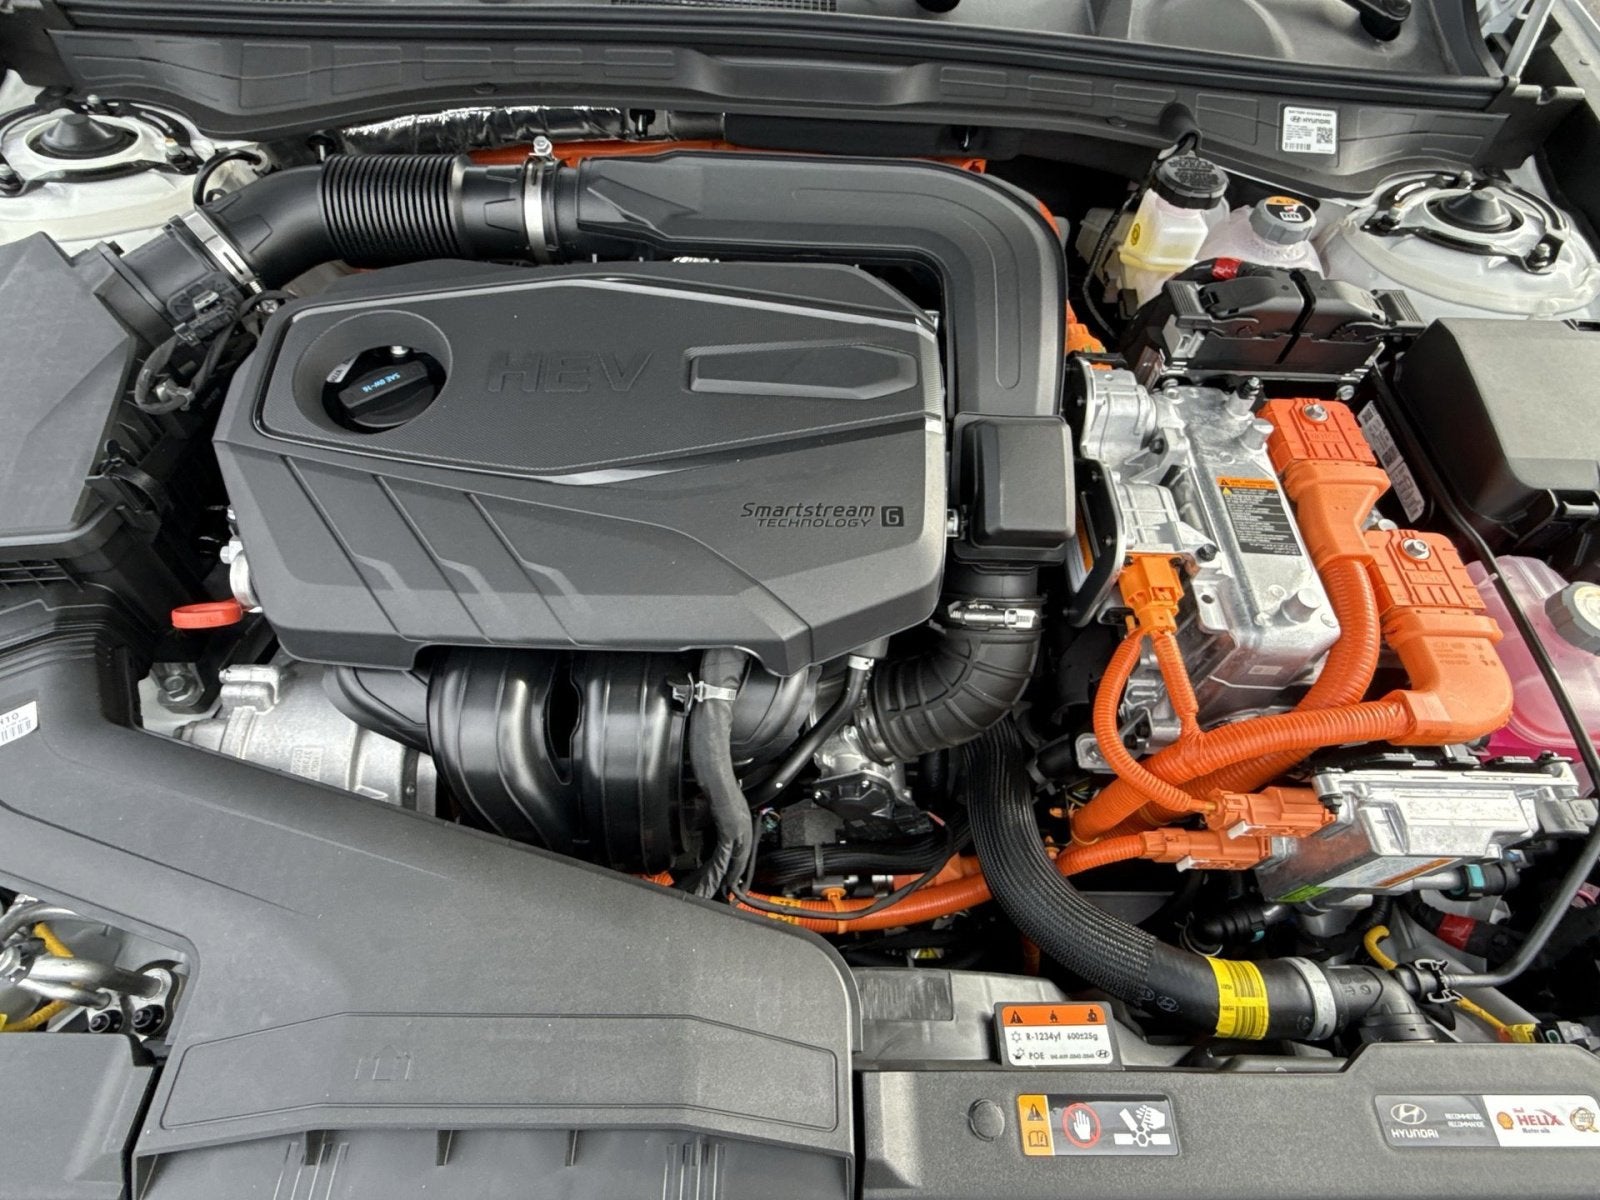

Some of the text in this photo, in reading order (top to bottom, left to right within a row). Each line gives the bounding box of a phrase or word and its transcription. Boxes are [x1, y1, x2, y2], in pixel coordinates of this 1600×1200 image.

[487, 350, 653, 393] HEV
[740, 502, 903, 526] Smartstream G
[757, 518, 872, 528] TECHNOLOGY
[1516, 1113, 1562, 1127] HELIX
[1391, 1129, 1440, 1139] HYUNDAI
